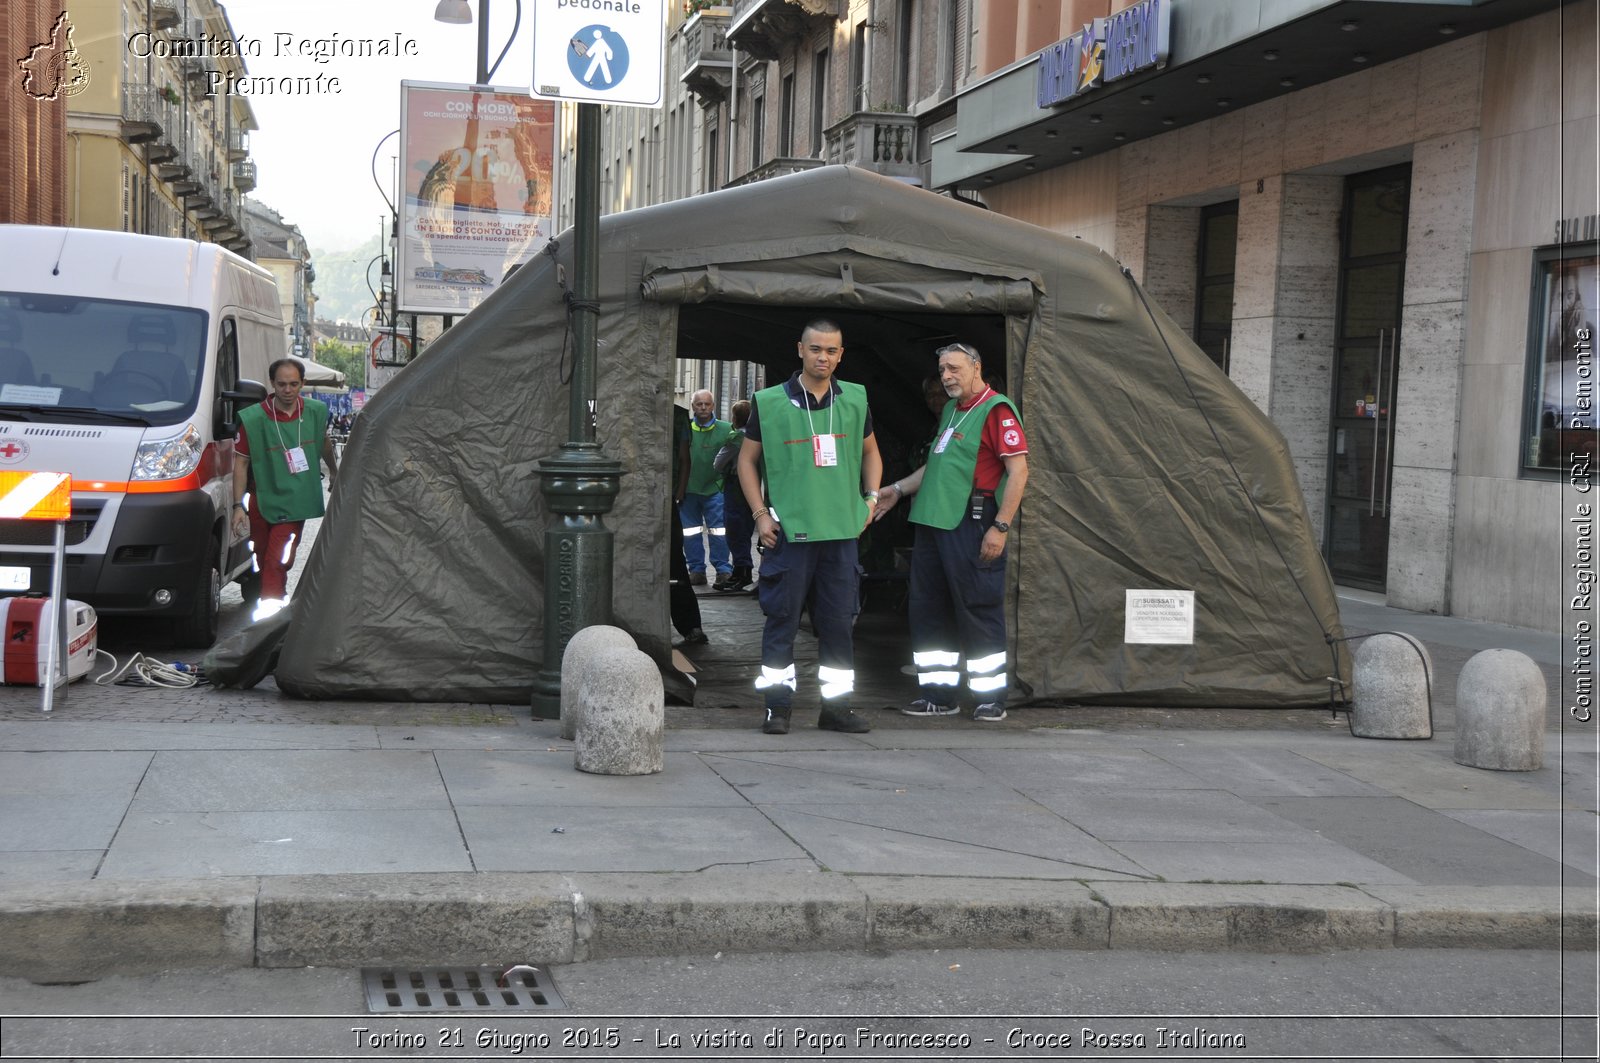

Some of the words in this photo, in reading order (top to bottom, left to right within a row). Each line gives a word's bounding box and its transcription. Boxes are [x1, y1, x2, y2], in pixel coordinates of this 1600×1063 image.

[558, 0, 640, 13] pedonale
[1037, 37, 1075, 109] CINEMA
[1103, 0, 1160, 82] MASSIMO
[446, 101, 472, 112] CON
[478, 103, 516, 115] MOBY,
[442, 112, 468, 120] GIORNO
[465, 226, 503, 235] SCONTO
[505, 228, 522, 236] DEL
[523, 229, 543, 237] 20%
[559, 538, 573, 594] TORINO
